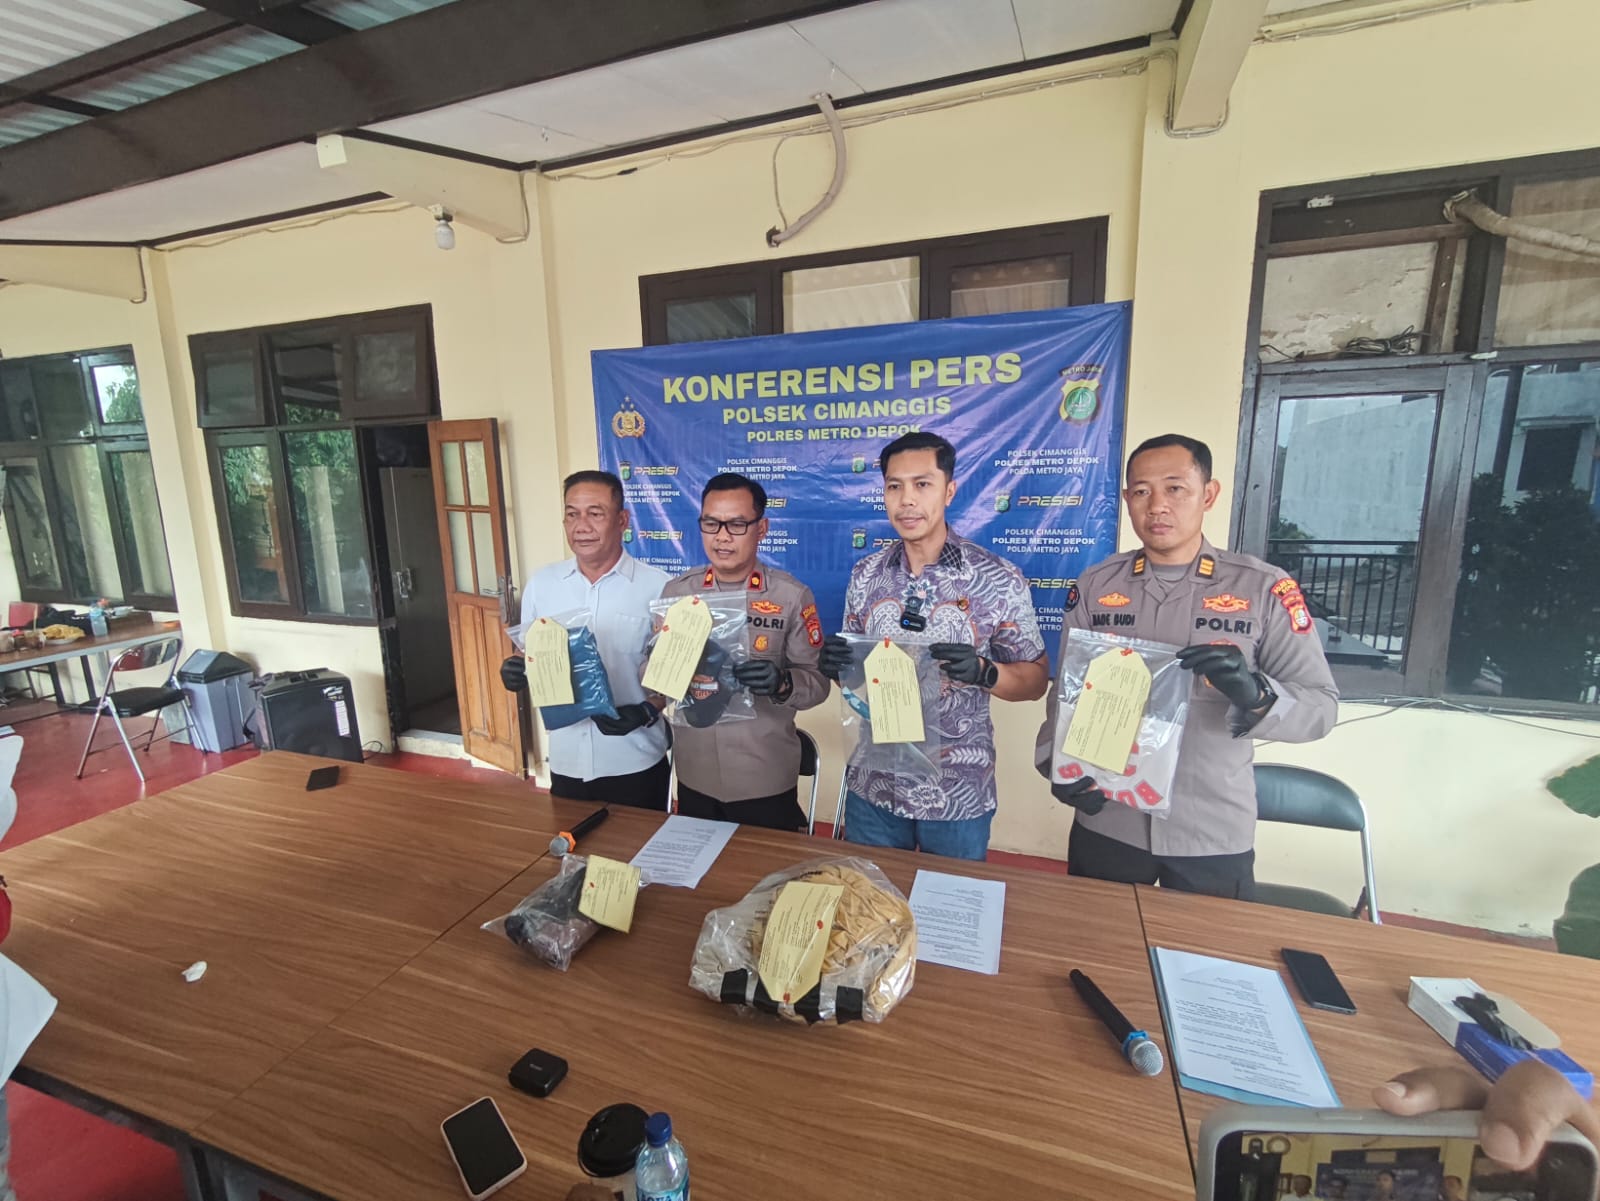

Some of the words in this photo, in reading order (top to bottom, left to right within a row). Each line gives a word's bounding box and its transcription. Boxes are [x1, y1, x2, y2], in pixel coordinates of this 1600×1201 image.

[663, 362, 894, 404] KONFERENSI
[910, 352, 1022, 389] PERS
[723, 404, 807, 424] POLSEK
[814, 397, 951, 420] CIMANGGIS
[747, 429, 804, 443] POLRES
[808, 426, 862, 440] METRO
[866, 423, 922, 438] DEPOK
[1008, 449, 1038, 457] POLSEK
[1040, 447, 1087, 456] CIMANGGIS
[994, 459, 1031, 467] POLRES
[1032, 458, 1064, 466] METRO
[634, 466, 679, 476] PRESISI
[1064, 466, 1083, 475] JAYA
[766, 498, 787, 508] SISI
[1018, 496, 1083, 507] PRESISI
[638, 530, 683, 541] PRESISI
[1005, 528, 1034, 536] POLSEK
[1036, 528, 1082, 536] CIMANGGIS
[1029, 537, 1061, 545] METRO
[772, 545, 787, 553] JAYA
[1061, 546, 1080, 554] JAYA
[747, 616, 785, 630] POLRI
[1195, 617, 1253, 635] POLRI
